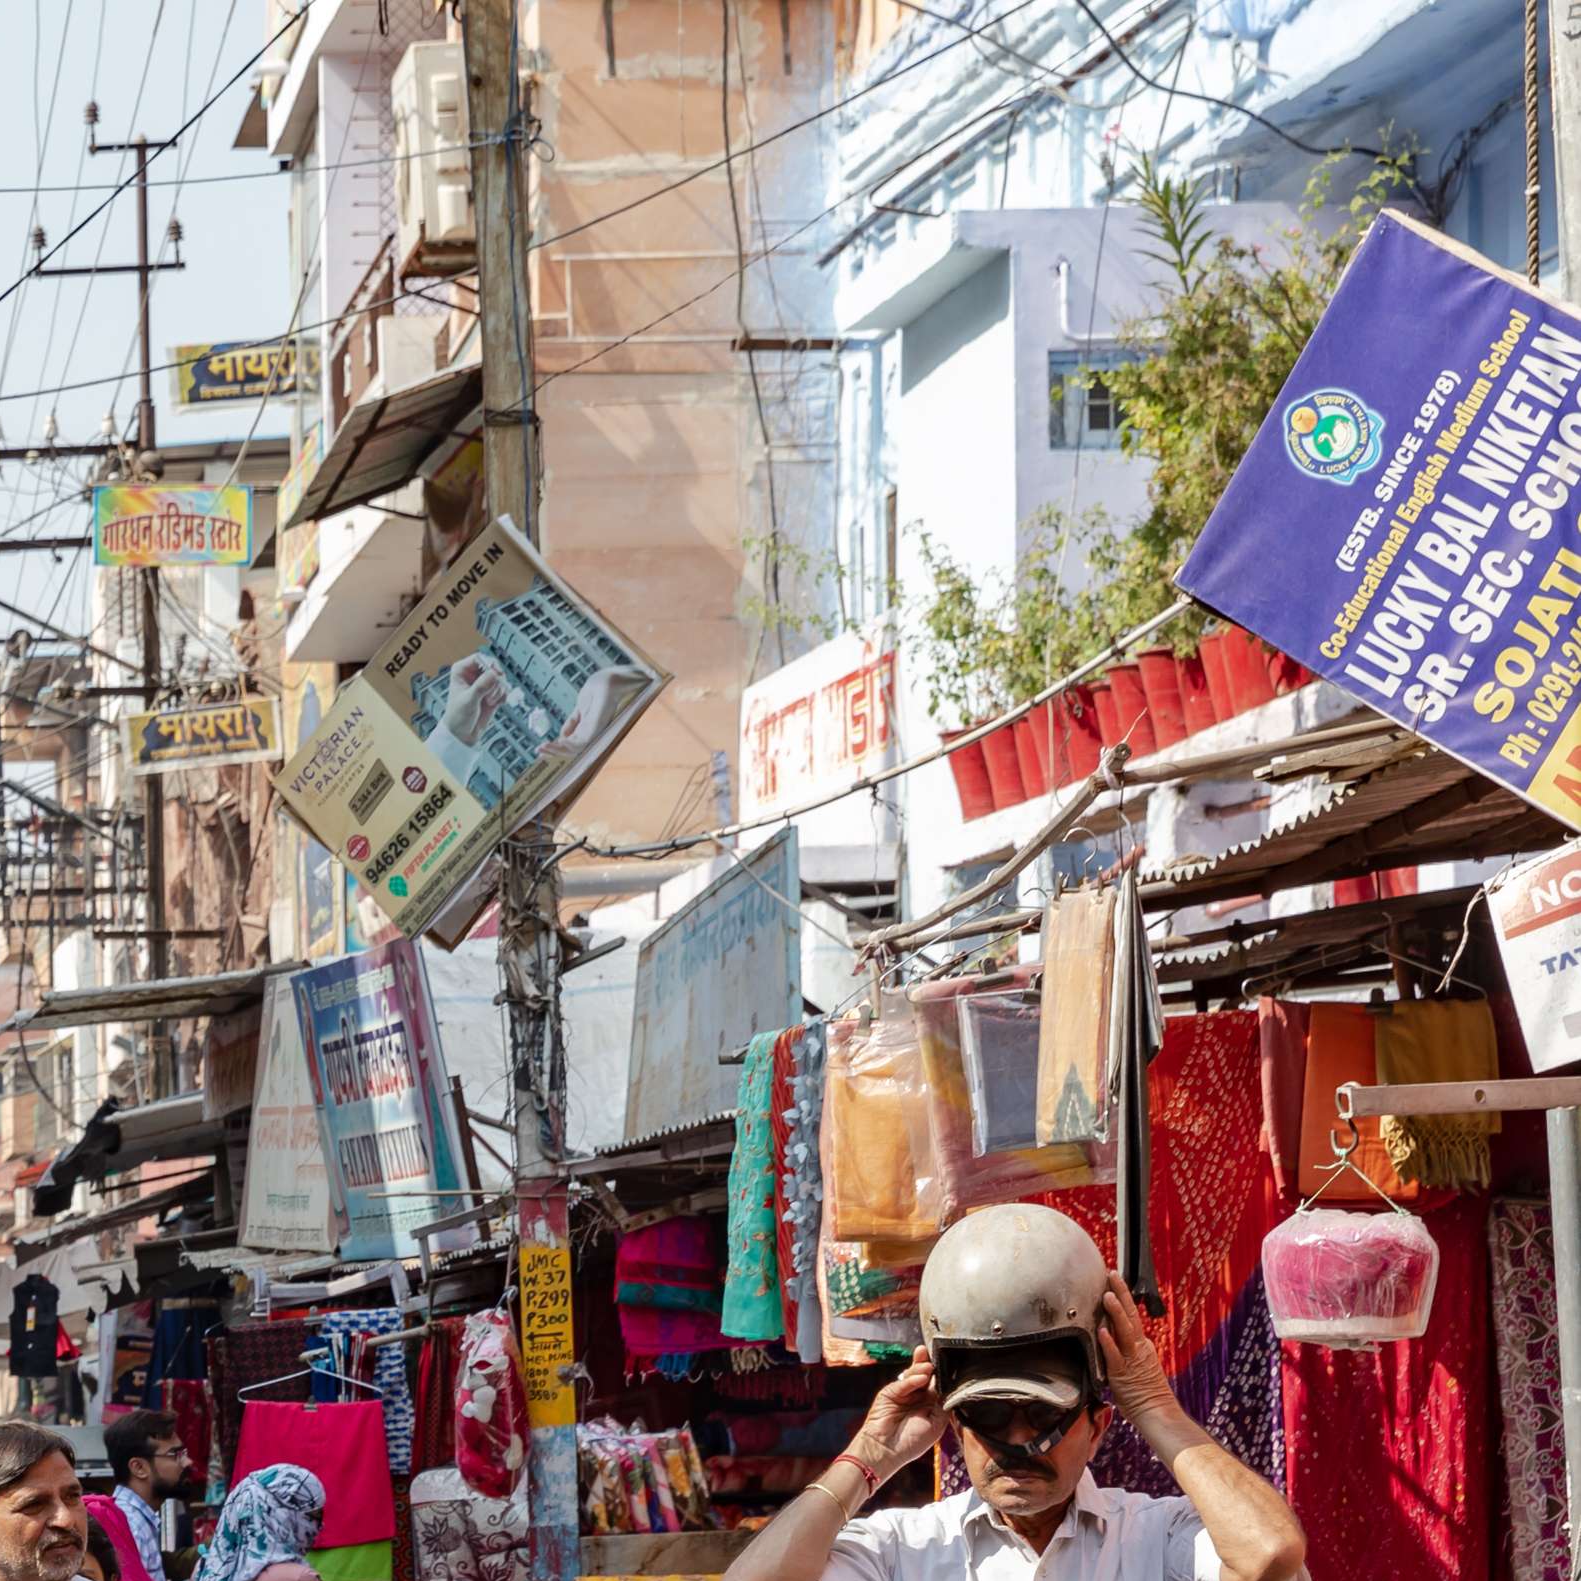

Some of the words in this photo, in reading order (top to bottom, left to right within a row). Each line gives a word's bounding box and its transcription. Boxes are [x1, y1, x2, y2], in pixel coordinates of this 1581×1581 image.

[1319, 519, 1412, 660] Co-Educational
[1395, 451, 1450, 525] English
[1435, 376, 1494, 455] Medium
[1478, 307, 1532, 379] School
[1334, 505, 1385, 573] (ESTB.
[1374, 431, 1424, 502] SINCE
[1413, 368, 1464, 435] 1978)
[1344, 558, 1453, 700] LUCKY
[1412, 491, 1501, 577] BAL
[1457, 322, 1581, 500] NIKETAN
[385, 630, 430, 677] READY
[430, 605, 450, 631] TO
[449, 559, 489, 608] MOVE
[486, 541, 506, 566] IN
[1402, 652, 1476, 723] SR.
[1448, 548, 1534, 644] SEC.
[289, 705, 365, 796] VICTORIAN
[314, 738, 363, 795] PALACE
[365, 832, 411, 886] 94626
[407, 782, 456, 838] 15864
